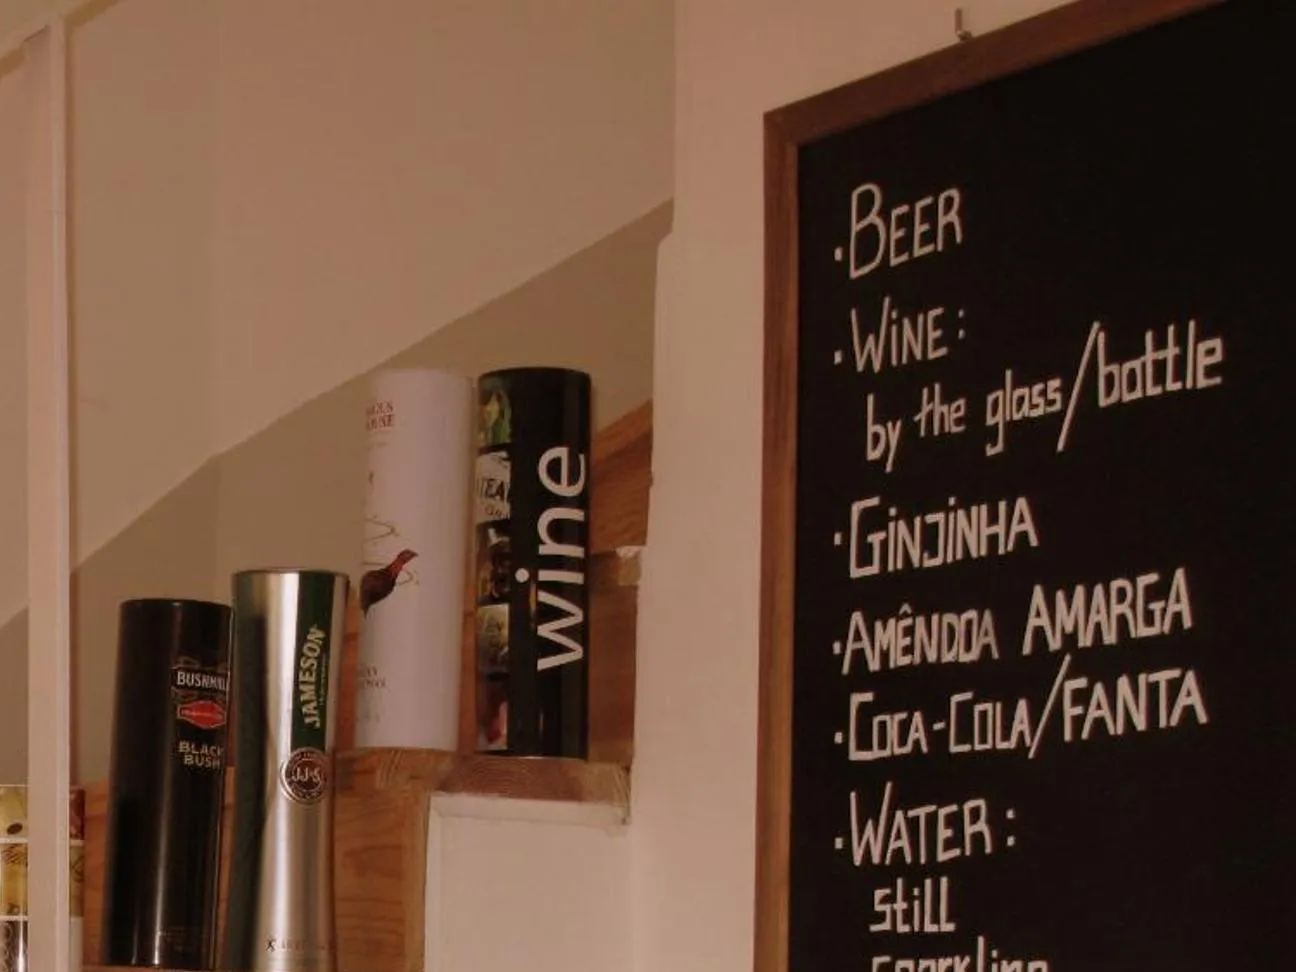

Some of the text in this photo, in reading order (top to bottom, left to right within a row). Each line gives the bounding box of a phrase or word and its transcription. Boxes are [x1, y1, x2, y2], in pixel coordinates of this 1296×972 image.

[849, 183, 962, 279] BEER
[866, 393, 902, 473] by
[913, 383, 966, 437] the
[515, 446, 586, 671] wine
[842, 567, 1193, 675] AMÊNDOA AMARGA
[299, 624, 325, 729] JAMESON
[183, 754, 221, 770] BUSH
